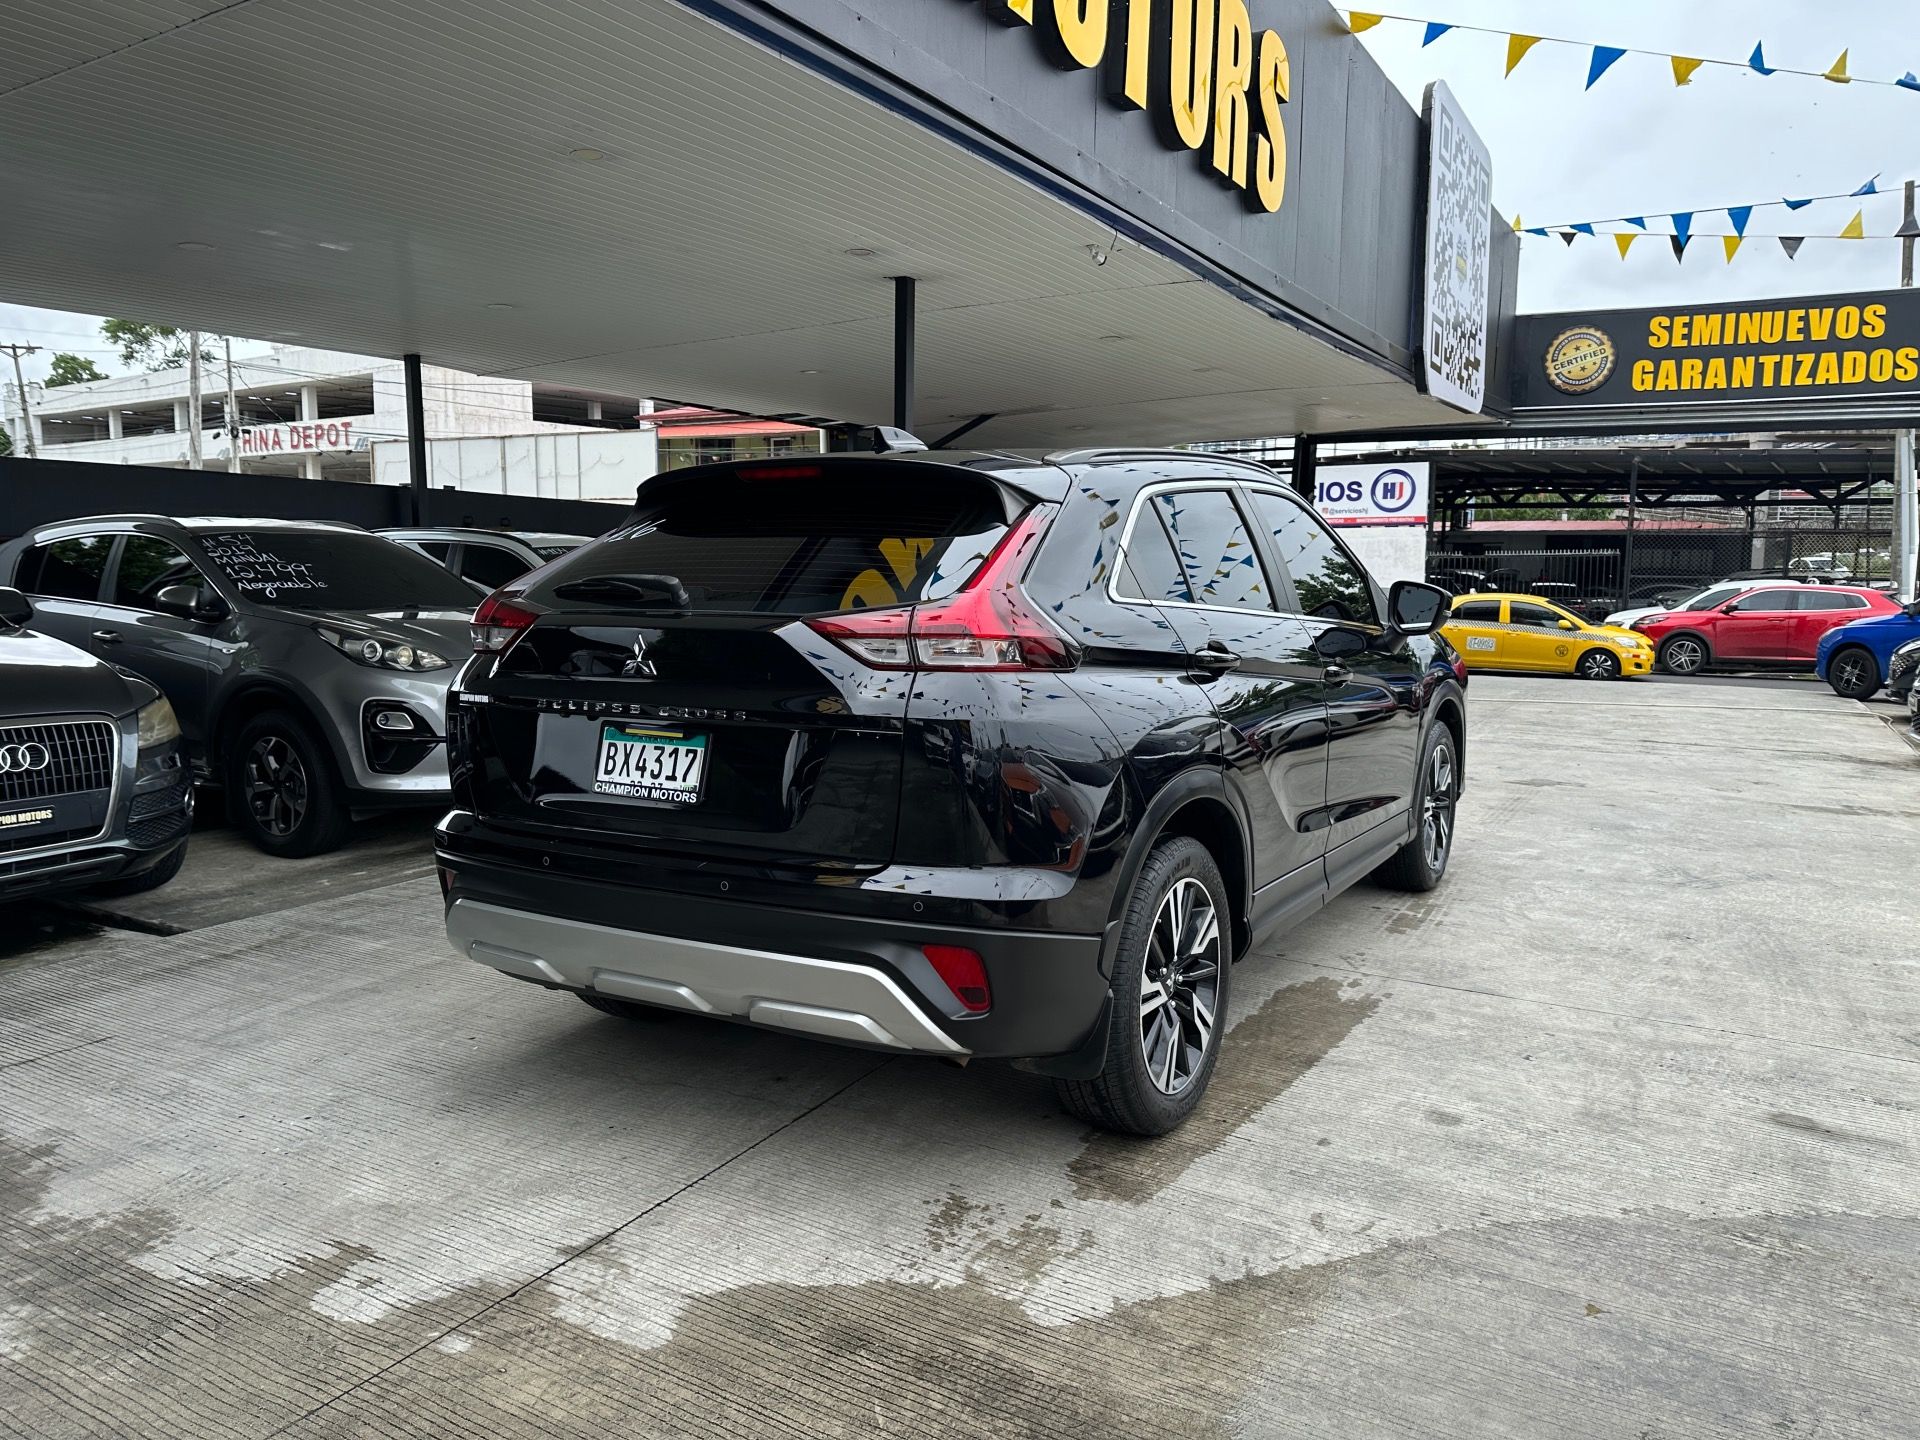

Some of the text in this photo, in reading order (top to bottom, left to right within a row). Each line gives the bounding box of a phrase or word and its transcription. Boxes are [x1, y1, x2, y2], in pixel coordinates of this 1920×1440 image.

[1648, 304, 1886, 348] SEMINUEVOS
[1553, 347, 1607, 371] CERTIFIED
[1631, 347, 1919, 392] GARANTIZADOS
[290, 421, 353, 449] DEPOT
[1382, 482, 1404, 501] HJ
[207, 544, 257, 557] 2019
[214, 552, 286, 565] MANUAL
[238, 577, 329, 598] Negociable
[536, 698, 747, 721] ECLIPSE CROSS
[603, 742, 699, 783] BX4317
[594, 782, 649, 798] CHAMPION
[650, 787, 698, 803] MOTORS
[18, 809, 53, 822] MOTORS
